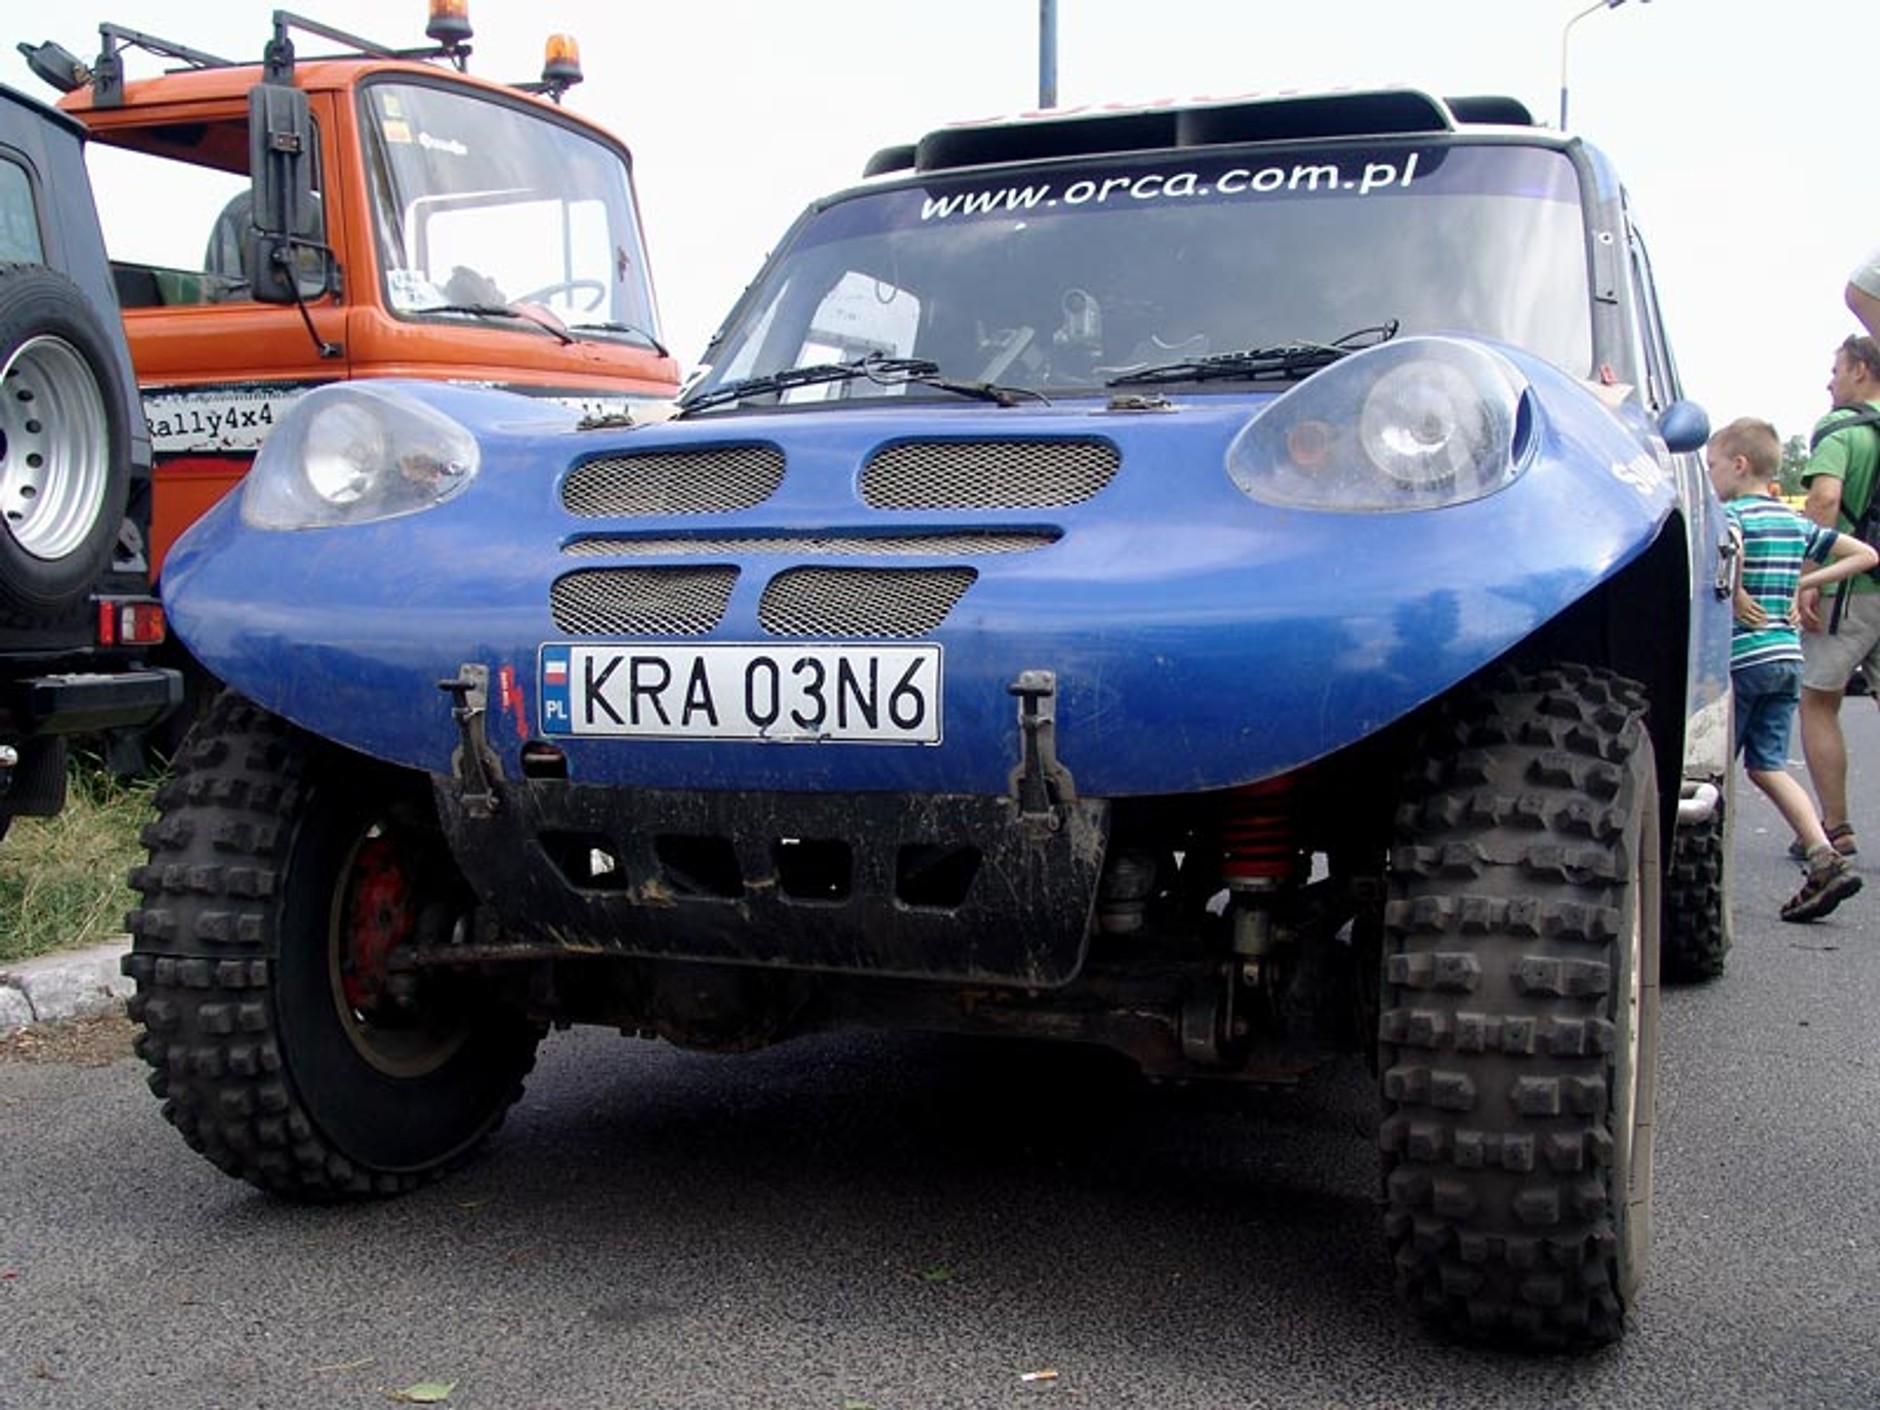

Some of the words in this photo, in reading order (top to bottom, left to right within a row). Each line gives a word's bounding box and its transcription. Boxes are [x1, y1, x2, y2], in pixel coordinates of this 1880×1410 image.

[920, 153, 1419, 220] www.orca.com.pl
[545, 700, 568, 719] PL
[584, 655, 719, 727] KRA
[745, 656, 926, 730] 03N6
